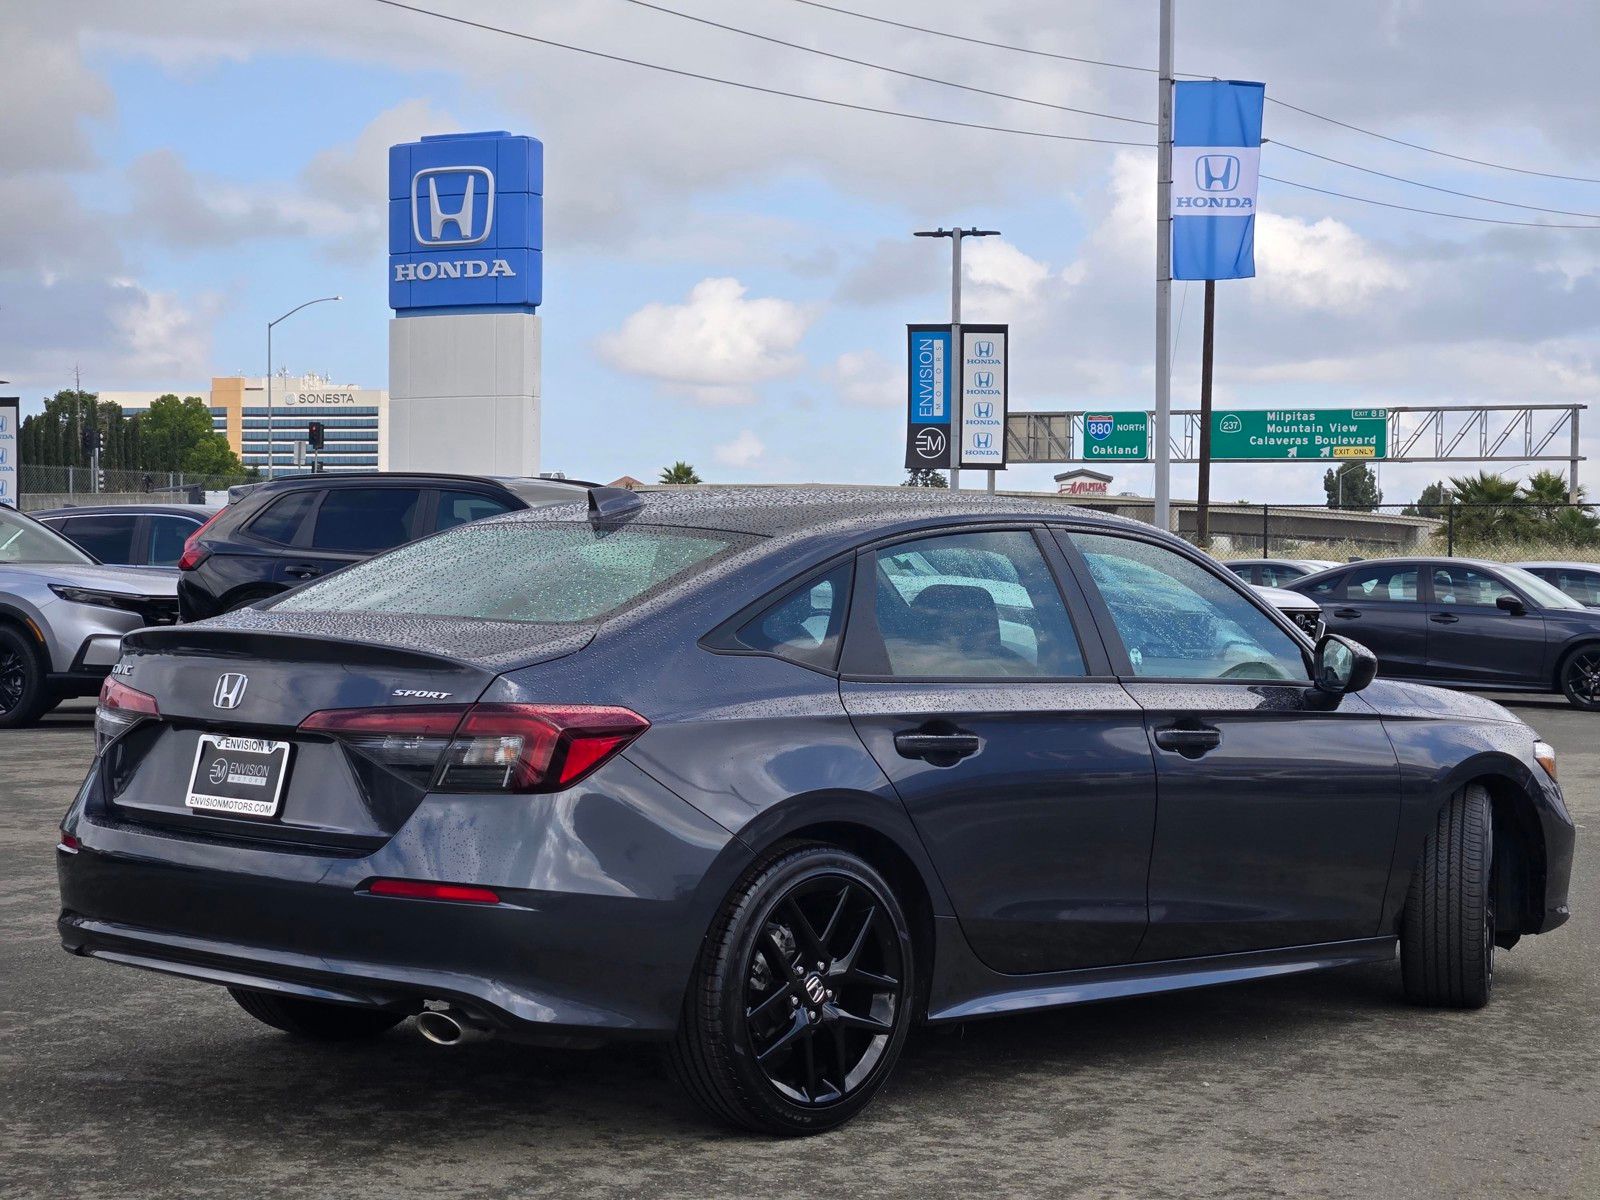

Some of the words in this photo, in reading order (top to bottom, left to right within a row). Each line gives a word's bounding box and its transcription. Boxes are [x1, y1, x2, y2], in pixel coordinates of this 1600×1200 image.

[1176, 196, 1253, 208] HONDA
[394, 259, 517, 282] HONDA
[919, 339, 933, 417] ENVISION
[298, 393, 355, 404] SONESTA
[1267, 411, 1316, 423] Milpitas
[1090, 423, 1111, 435] 880
[1116, 423, 1145, 431] NORTH
[1223, 421, 1238, 430] 237
[1267, 423, 1323, 433] Mountain
[1329, 423, 1358, 433] View
[1249, 435, 1308, 445] Calaveras
[1315, 435, 1376, 445] Boulevard
[1092, 445, 1138, 455] Oakland
[392, 689, 453, 700] SPORT
[225, 738, 265, 752] ENVISION
[229, 762, 270, 777] ENVISION
[189, 796, 272, 814] ENVISIONMOTORS.COM
